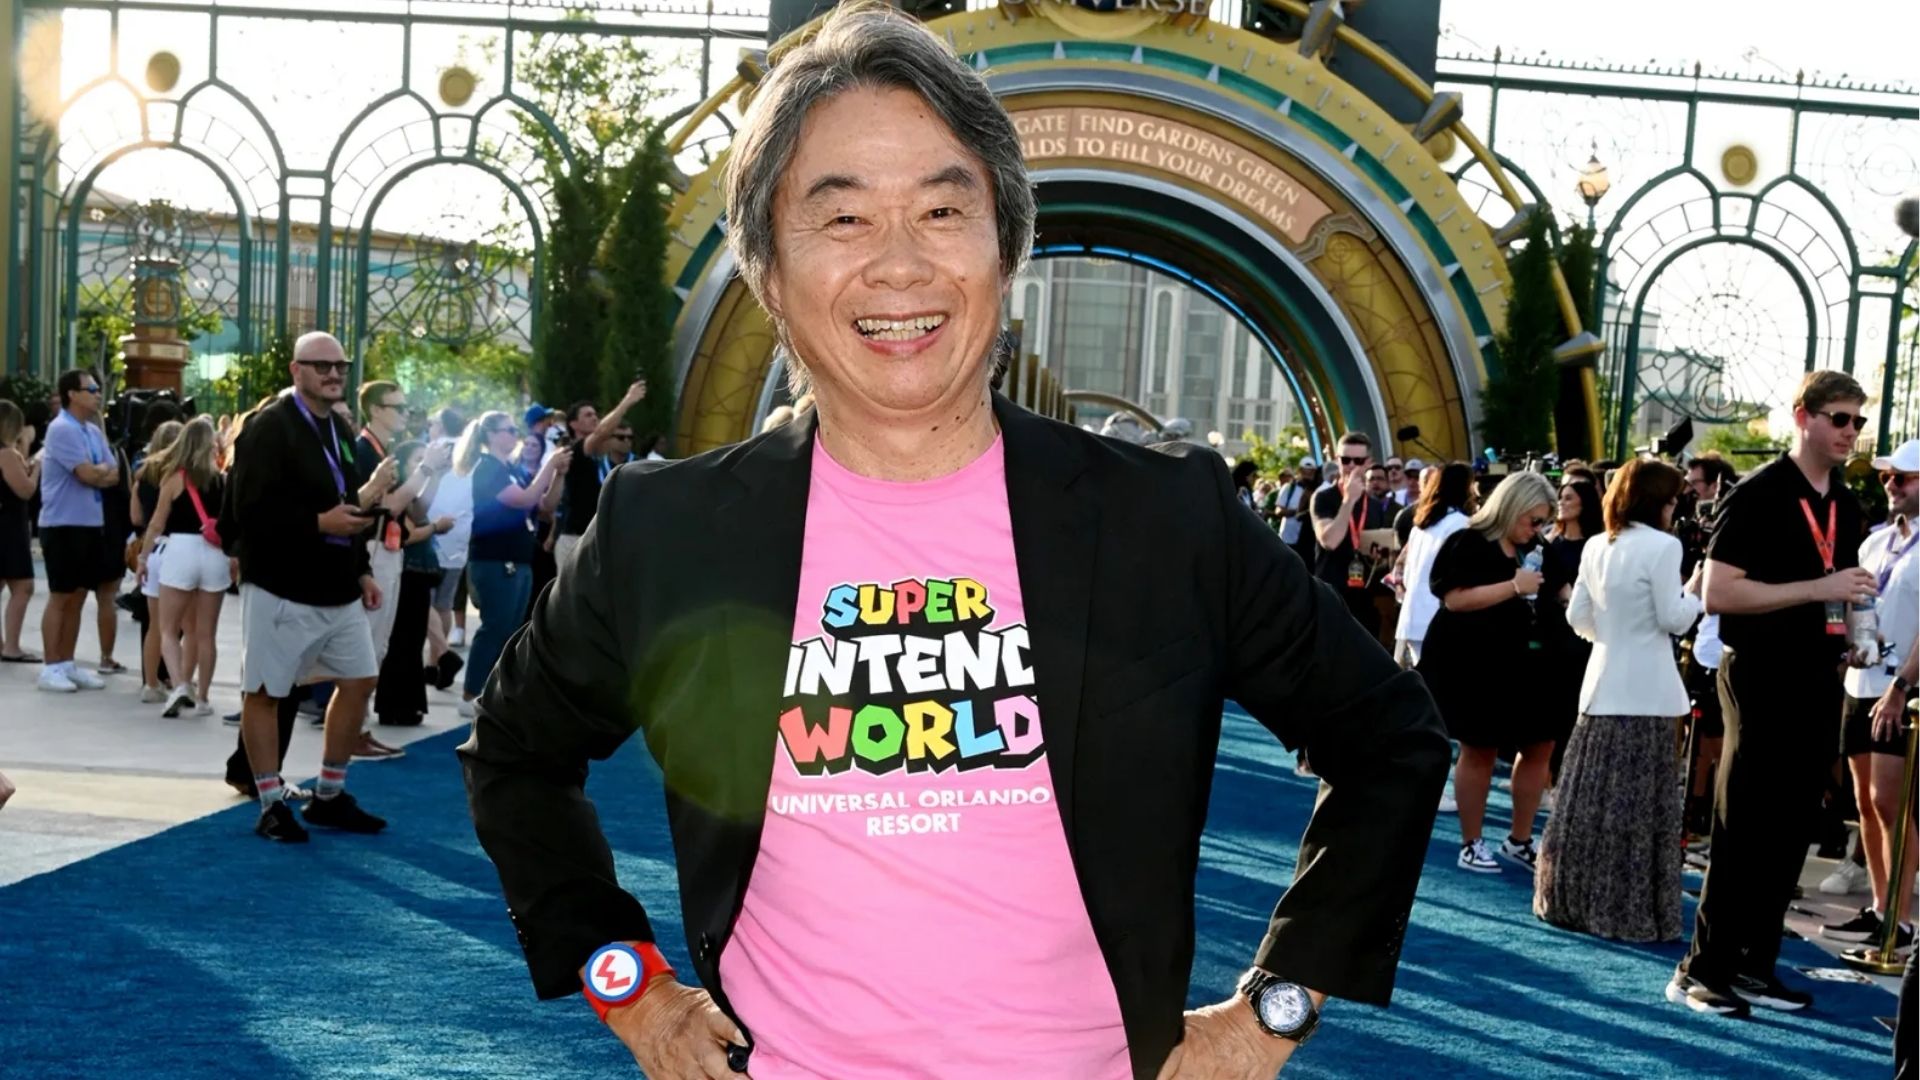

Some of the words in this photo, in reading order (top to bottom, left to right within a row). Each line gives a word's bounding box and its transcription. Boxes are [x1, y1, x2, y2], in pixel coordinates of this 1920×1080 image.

[1074, 137, 1105, 156] TO
[1111, 140, 1150, 162] FILL
[1157, 150, 1212, 184] YOUR
[1216, 174, 1297, 231] DREAMS
[1080, 114, 1133, 135] FIND
[1138, 122, 1236, 167] GARDENS
[1236, 156, 1301, 206] GREEN
[822, 577, 992, 629] SUPER
[778, 695, 1045, 768] WORLD
[771, 791, 911, 815] UNIVERSAL
[918, 787, 1050, 808] ORLANDO
[866, 813, 961, 837] RESORT
